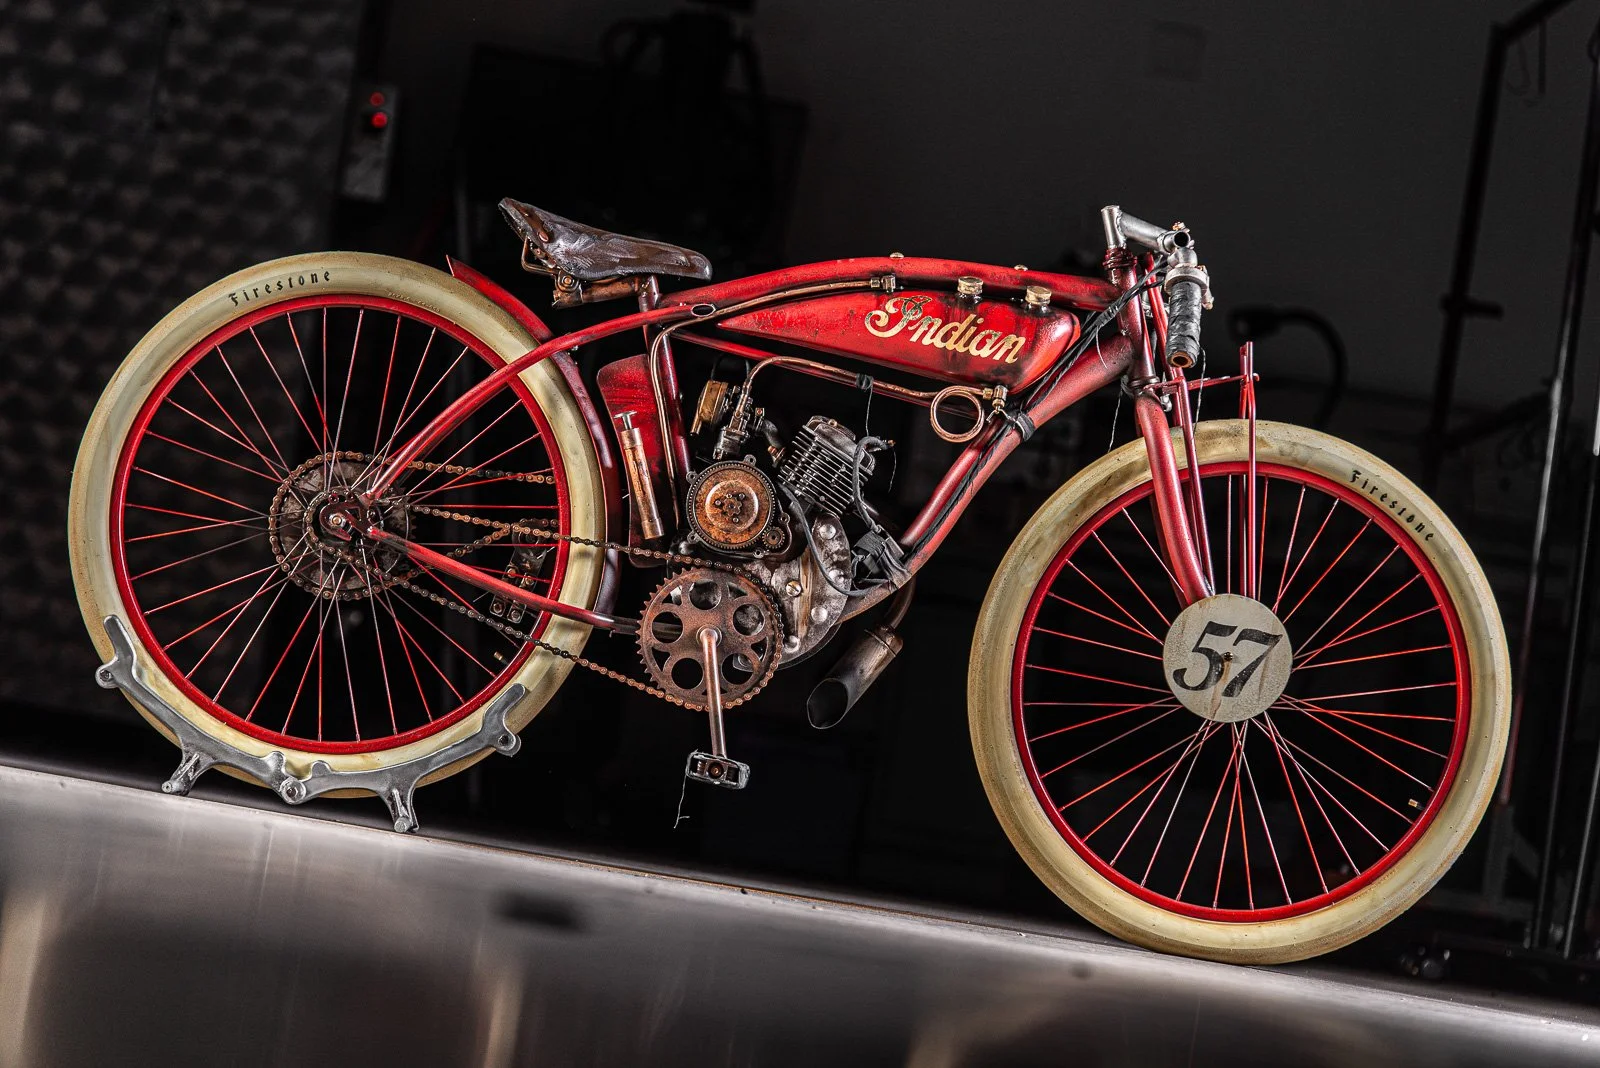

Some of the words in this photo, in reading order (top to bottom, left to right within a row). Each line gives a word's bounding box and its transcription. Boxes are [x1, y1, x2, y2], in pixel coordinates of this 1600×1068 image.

[228, 271, 330, 307] Firestone
[864, 295, 1026, 364] Indian
[1349, 469, 1434, 541] Firestone
[1172, 620, 1283, 698] 57
